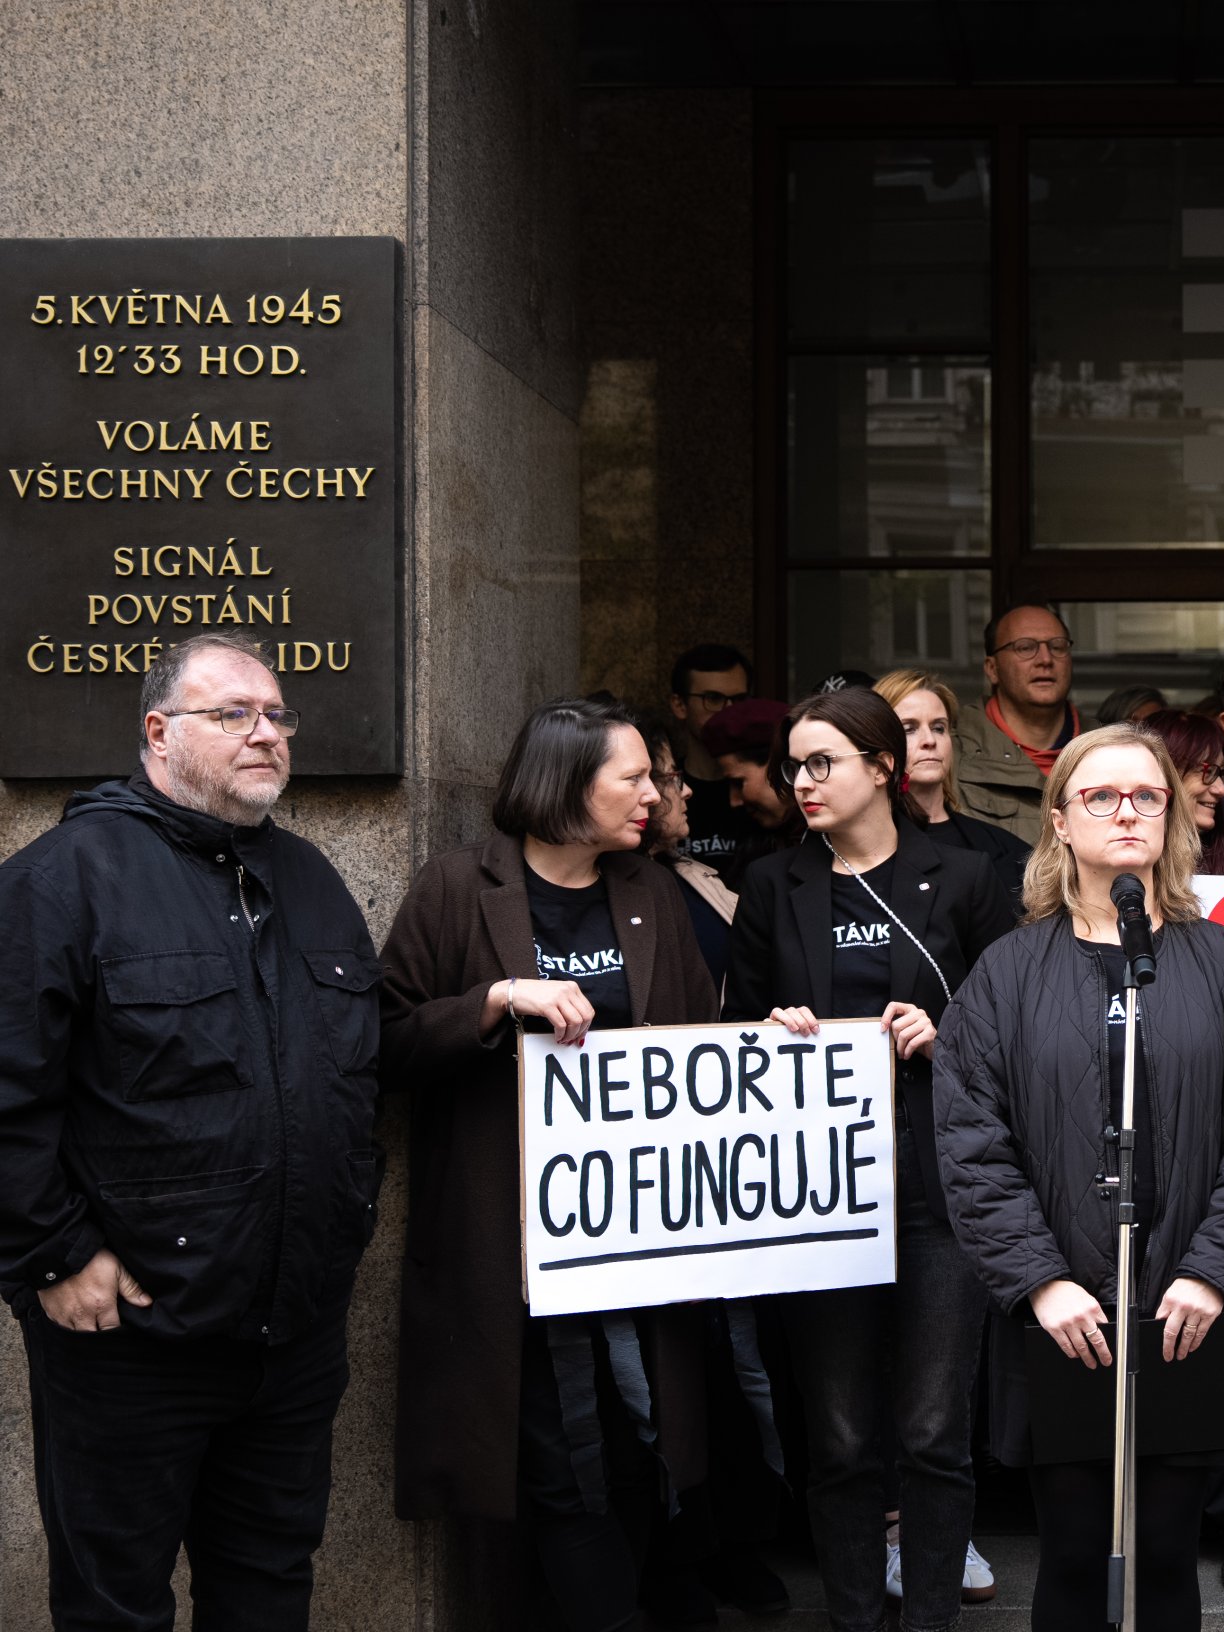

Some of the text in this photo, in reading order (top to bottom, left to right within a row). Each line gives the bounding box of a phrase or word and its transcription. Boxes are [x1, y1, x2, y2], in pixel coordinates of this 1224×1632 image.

[246, 288, 342, 325] 1945
[200, 345, 305, 374] HOD.
[98, 413, 271, 451] VOLÁME
[10, 461, 374, 499] VŠECHNY ČECHY
[114, 538, 271, 576] SIGNÁL
[89, 586, 290, 624] POVSTÁNÍ
[27, 635, 352, 673] ČESKÉ IDU
[544, 1032, 872, 1126] NEBOŘTE,
[539, 1120, 879, 1237] CO FUNGUJE
